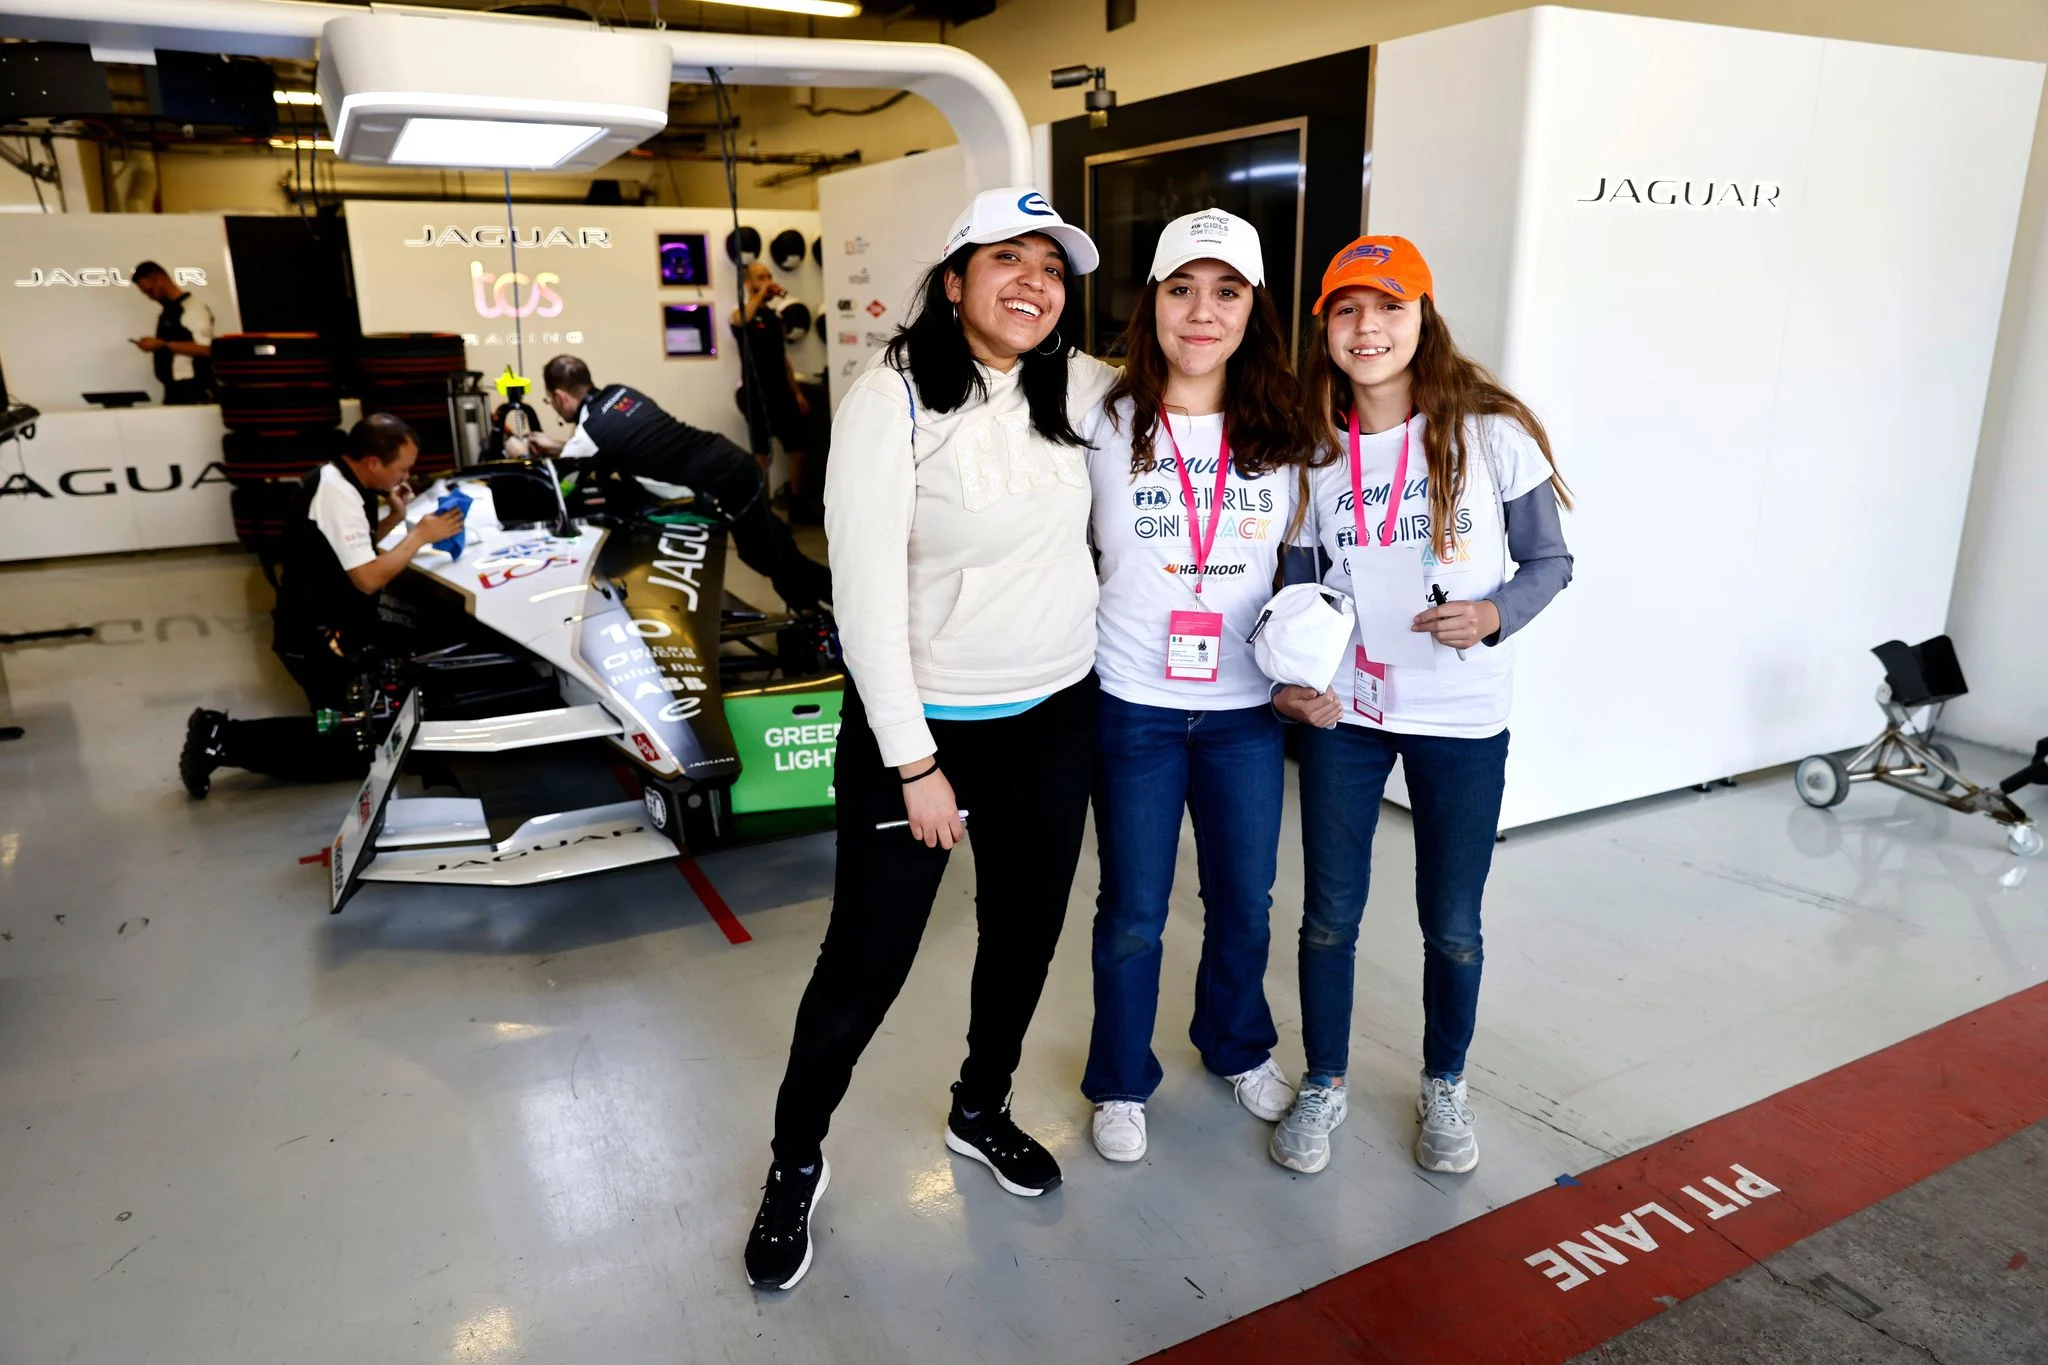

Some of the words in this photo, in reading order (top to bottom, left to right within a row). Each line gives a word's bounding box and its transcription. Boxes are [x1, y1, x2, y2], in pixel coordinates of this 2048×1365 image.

[1576, 177, 1781, 208] JAGUAR
[403, 224, 613, 249] JAGUAR
[14, 266, 209, 288] JAGUR
[1179, 487, 1274, 513] GIRLS
[1334, 476, 1429, 515] FORMLA
[1134, 515, 1180, 539] ON
[647, 522, 710, 612] JAGU
[600, 618, 673, 644] 10
[634, 676, 708, 701] ABB
[687, 756, 735, 769] JAGUAR
[1680, 1163, 1782, 1221] PIT
[1523, 1201, 1696, 1292] LANE
